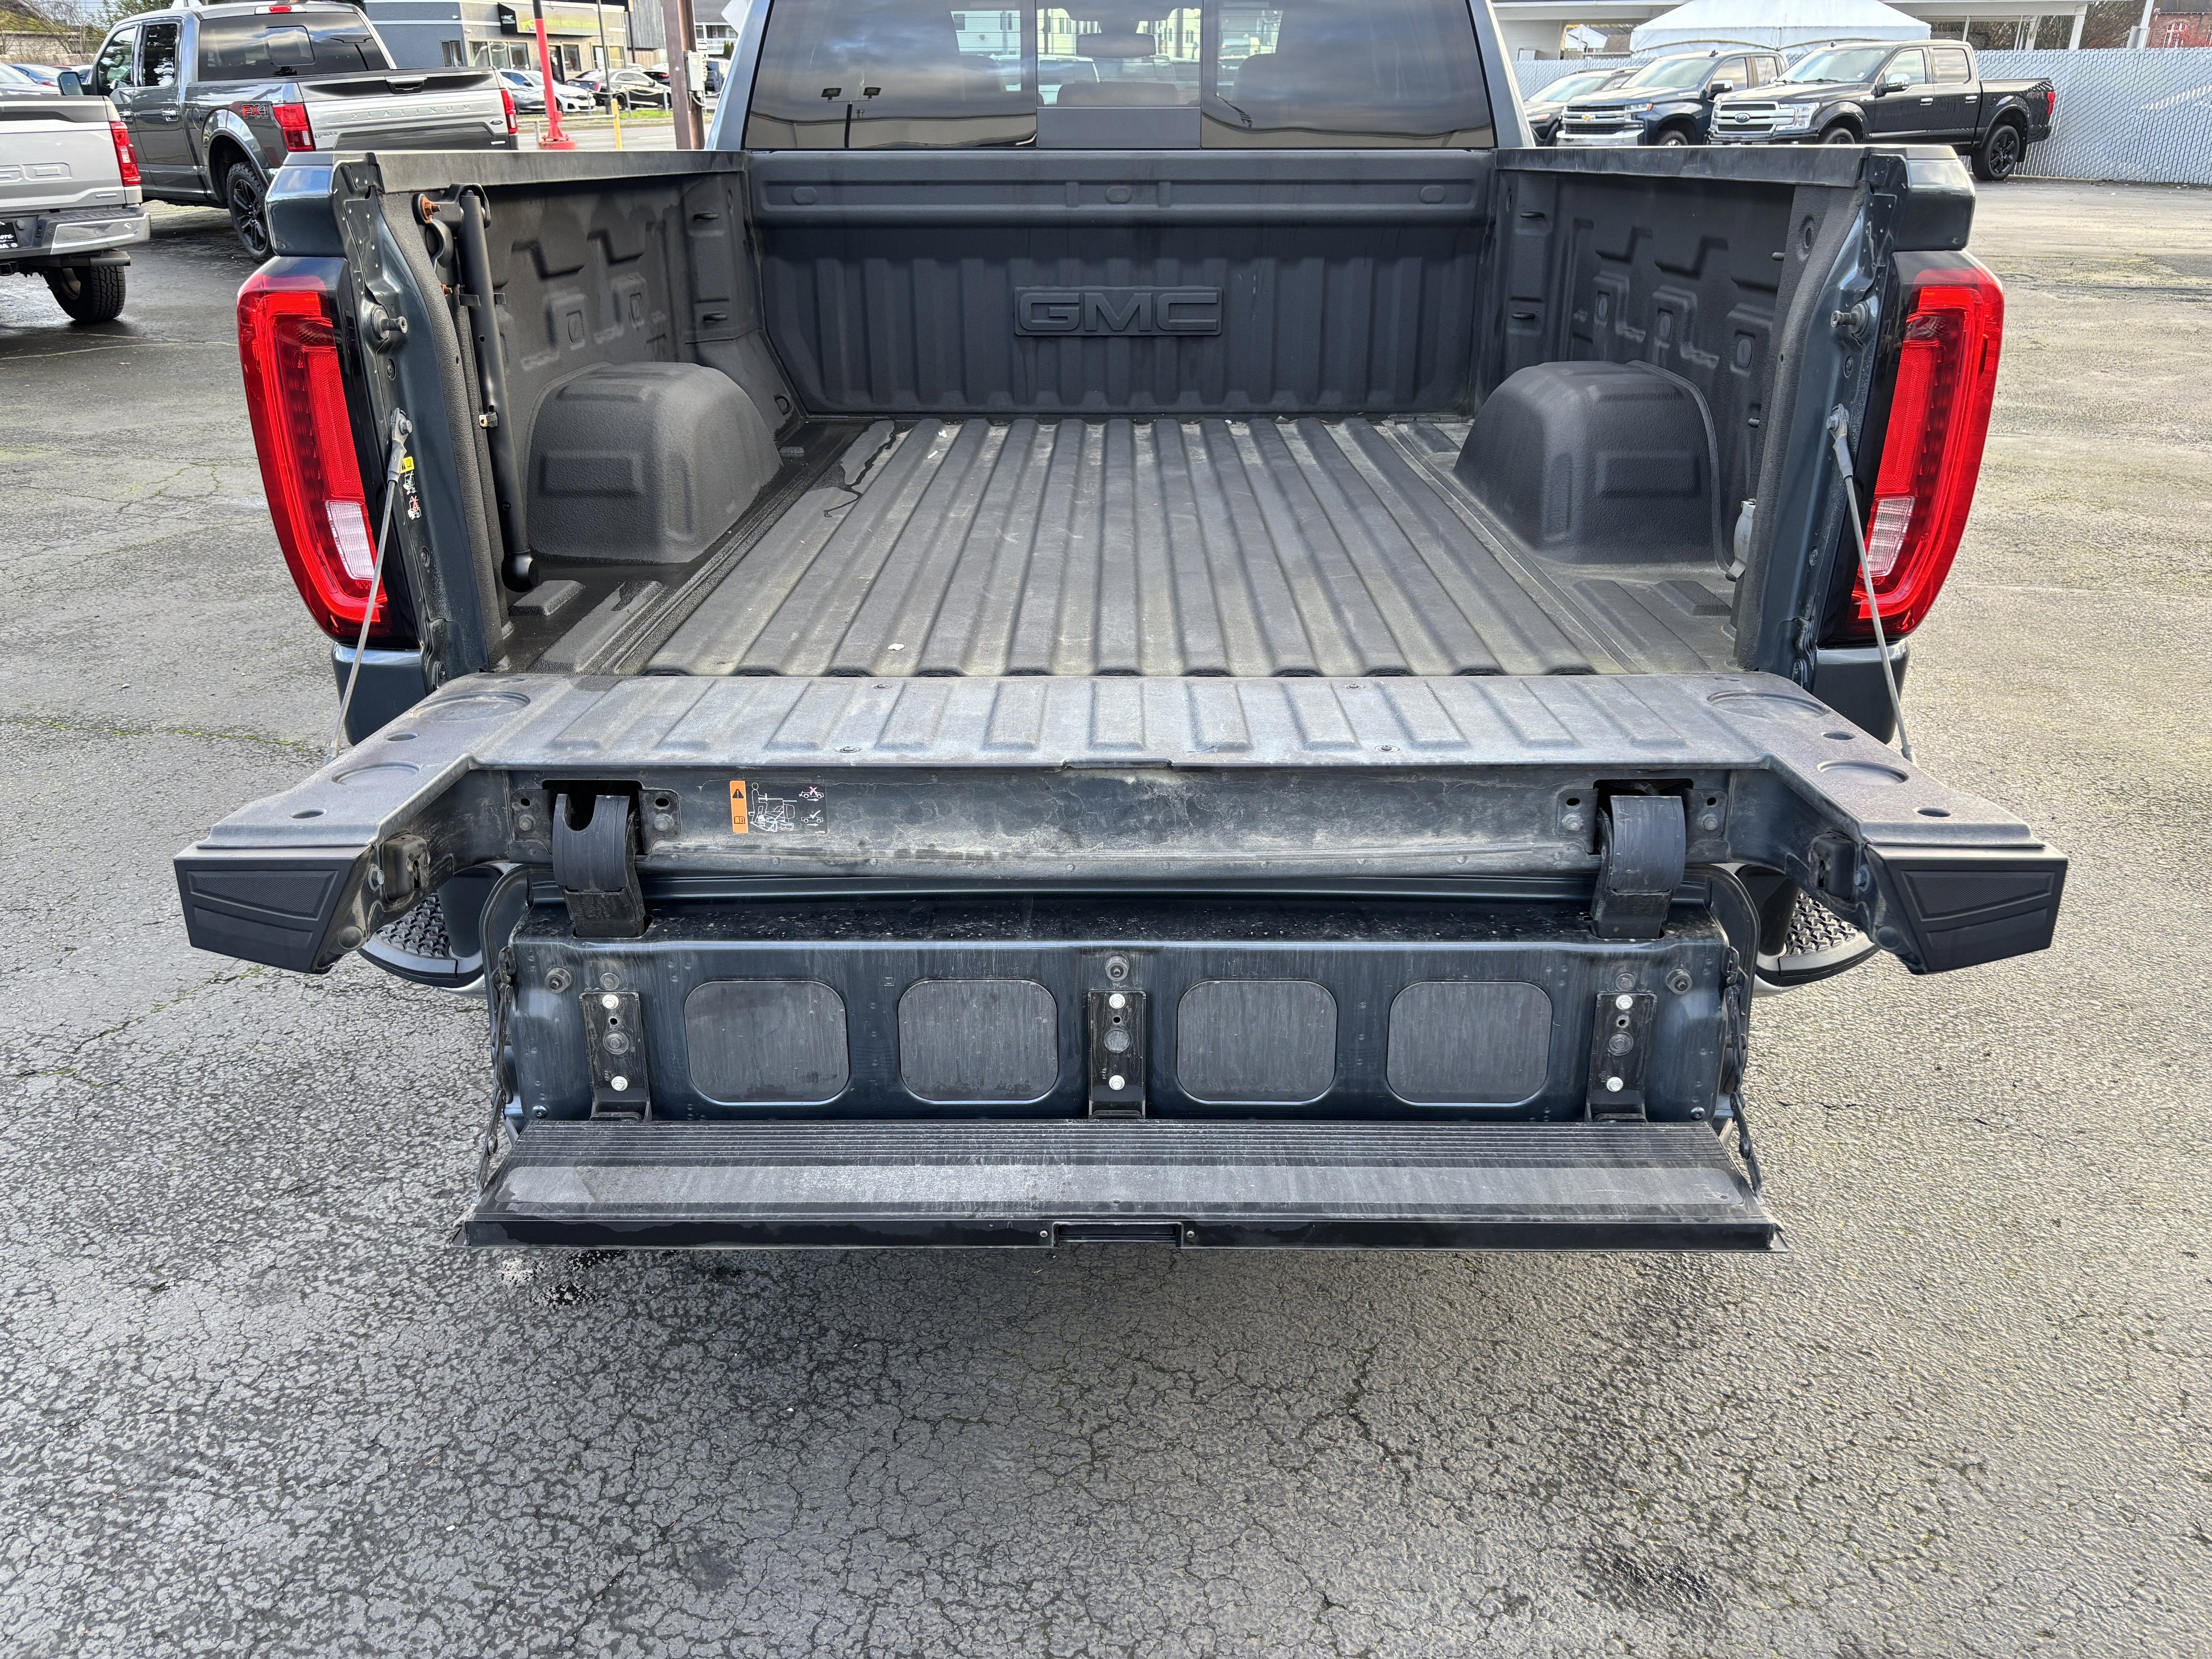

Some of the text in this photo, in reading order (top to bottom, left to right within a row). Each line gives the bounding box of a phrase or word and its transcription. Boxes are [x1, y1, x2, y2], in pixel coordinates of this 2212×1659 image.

[241, 103, 268, 118] FX4
[351, 104, 472, 120] PLATINUM
[1019, 292, 1219, 331] GMC
